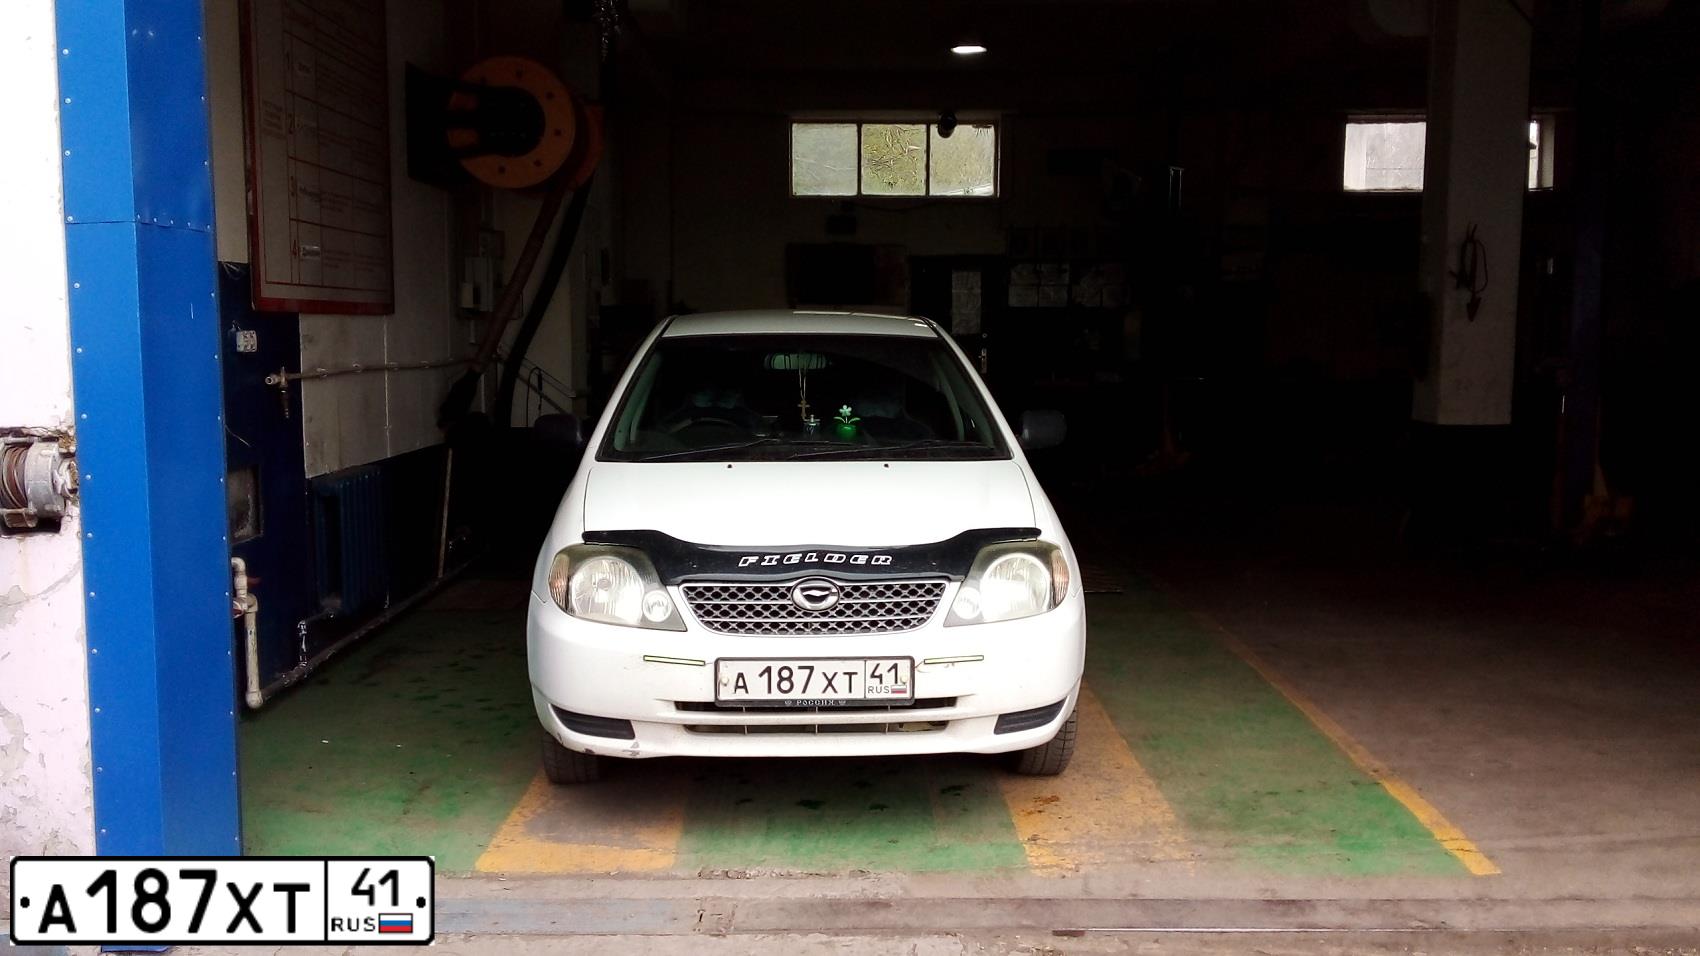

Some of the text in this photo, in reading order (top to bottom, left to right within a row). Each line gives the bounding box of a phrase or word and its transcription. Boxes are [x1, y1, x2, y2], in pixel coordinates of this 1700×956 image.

[738, 552, 893, 567] FIELDER
[869, 663, 901, 685] 41
[867, 685, 890, 694] RUS
